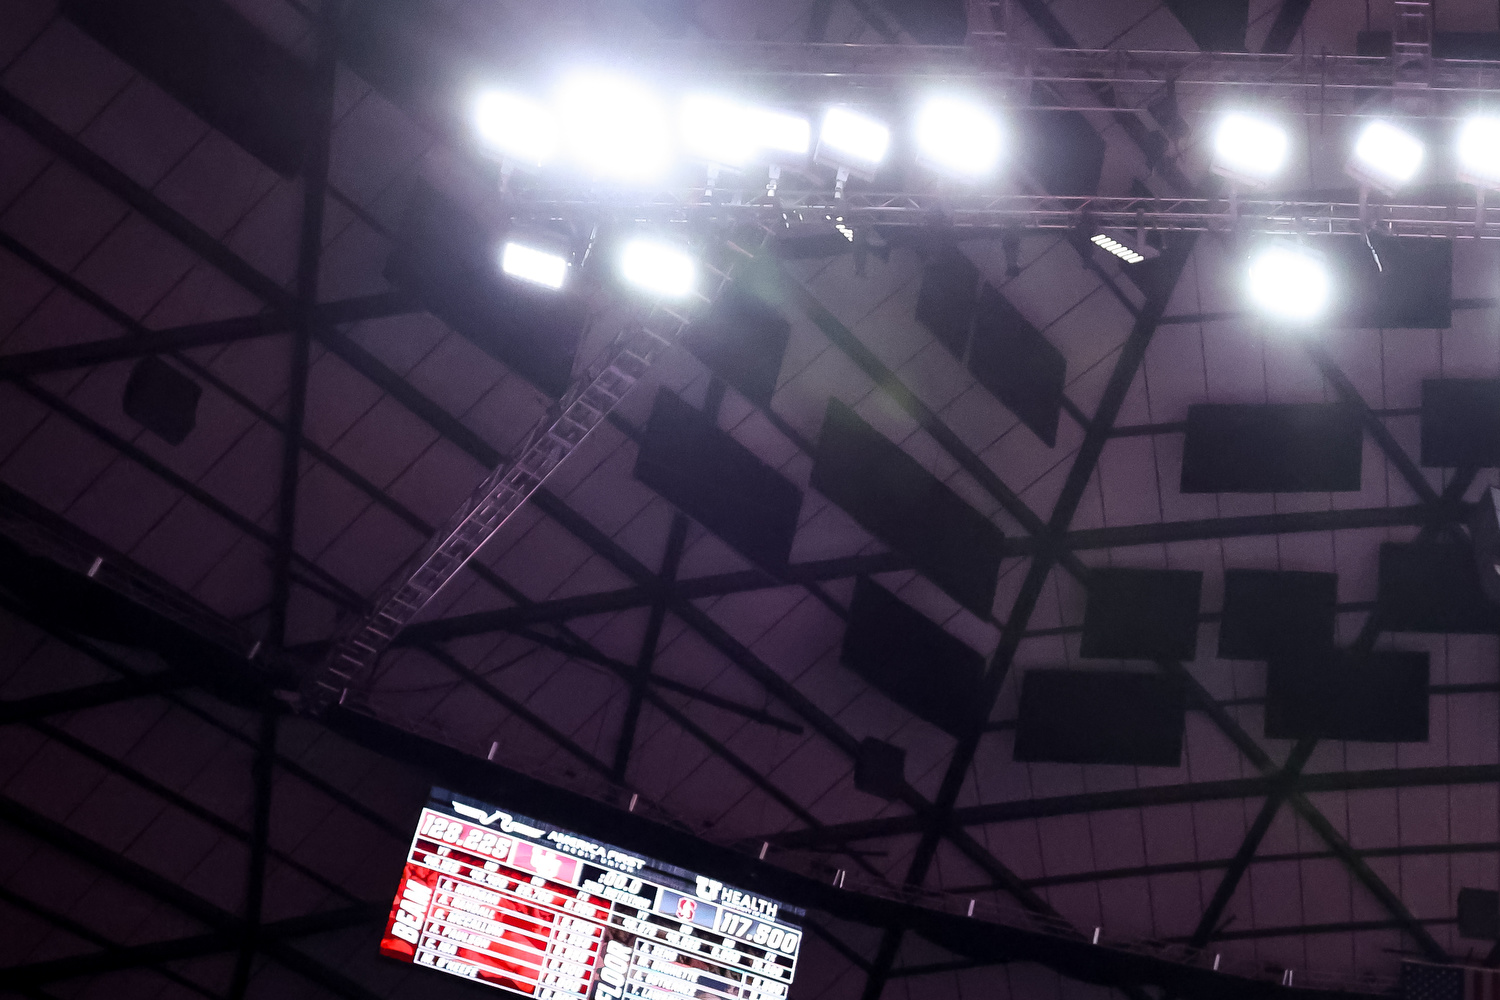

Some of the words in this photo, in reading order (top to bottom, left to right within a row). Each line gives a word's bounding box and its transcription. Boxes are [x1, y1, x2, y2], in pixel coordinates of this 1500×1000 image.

[420, 814, 512, 859] 128.225
[547, 831, 606, 858] AMERICA
[606, 850, 647, 869] FIRST
[556, 843, 596, 860] CREDIT
[600, 857, 635, 873] UNION
[598, 871, 642, 894] :00.0
[391, 879, 432, 944] BEAM
[721, 887, 778, 917] HEALTH
[720, 912, 798, 954] 117.500
